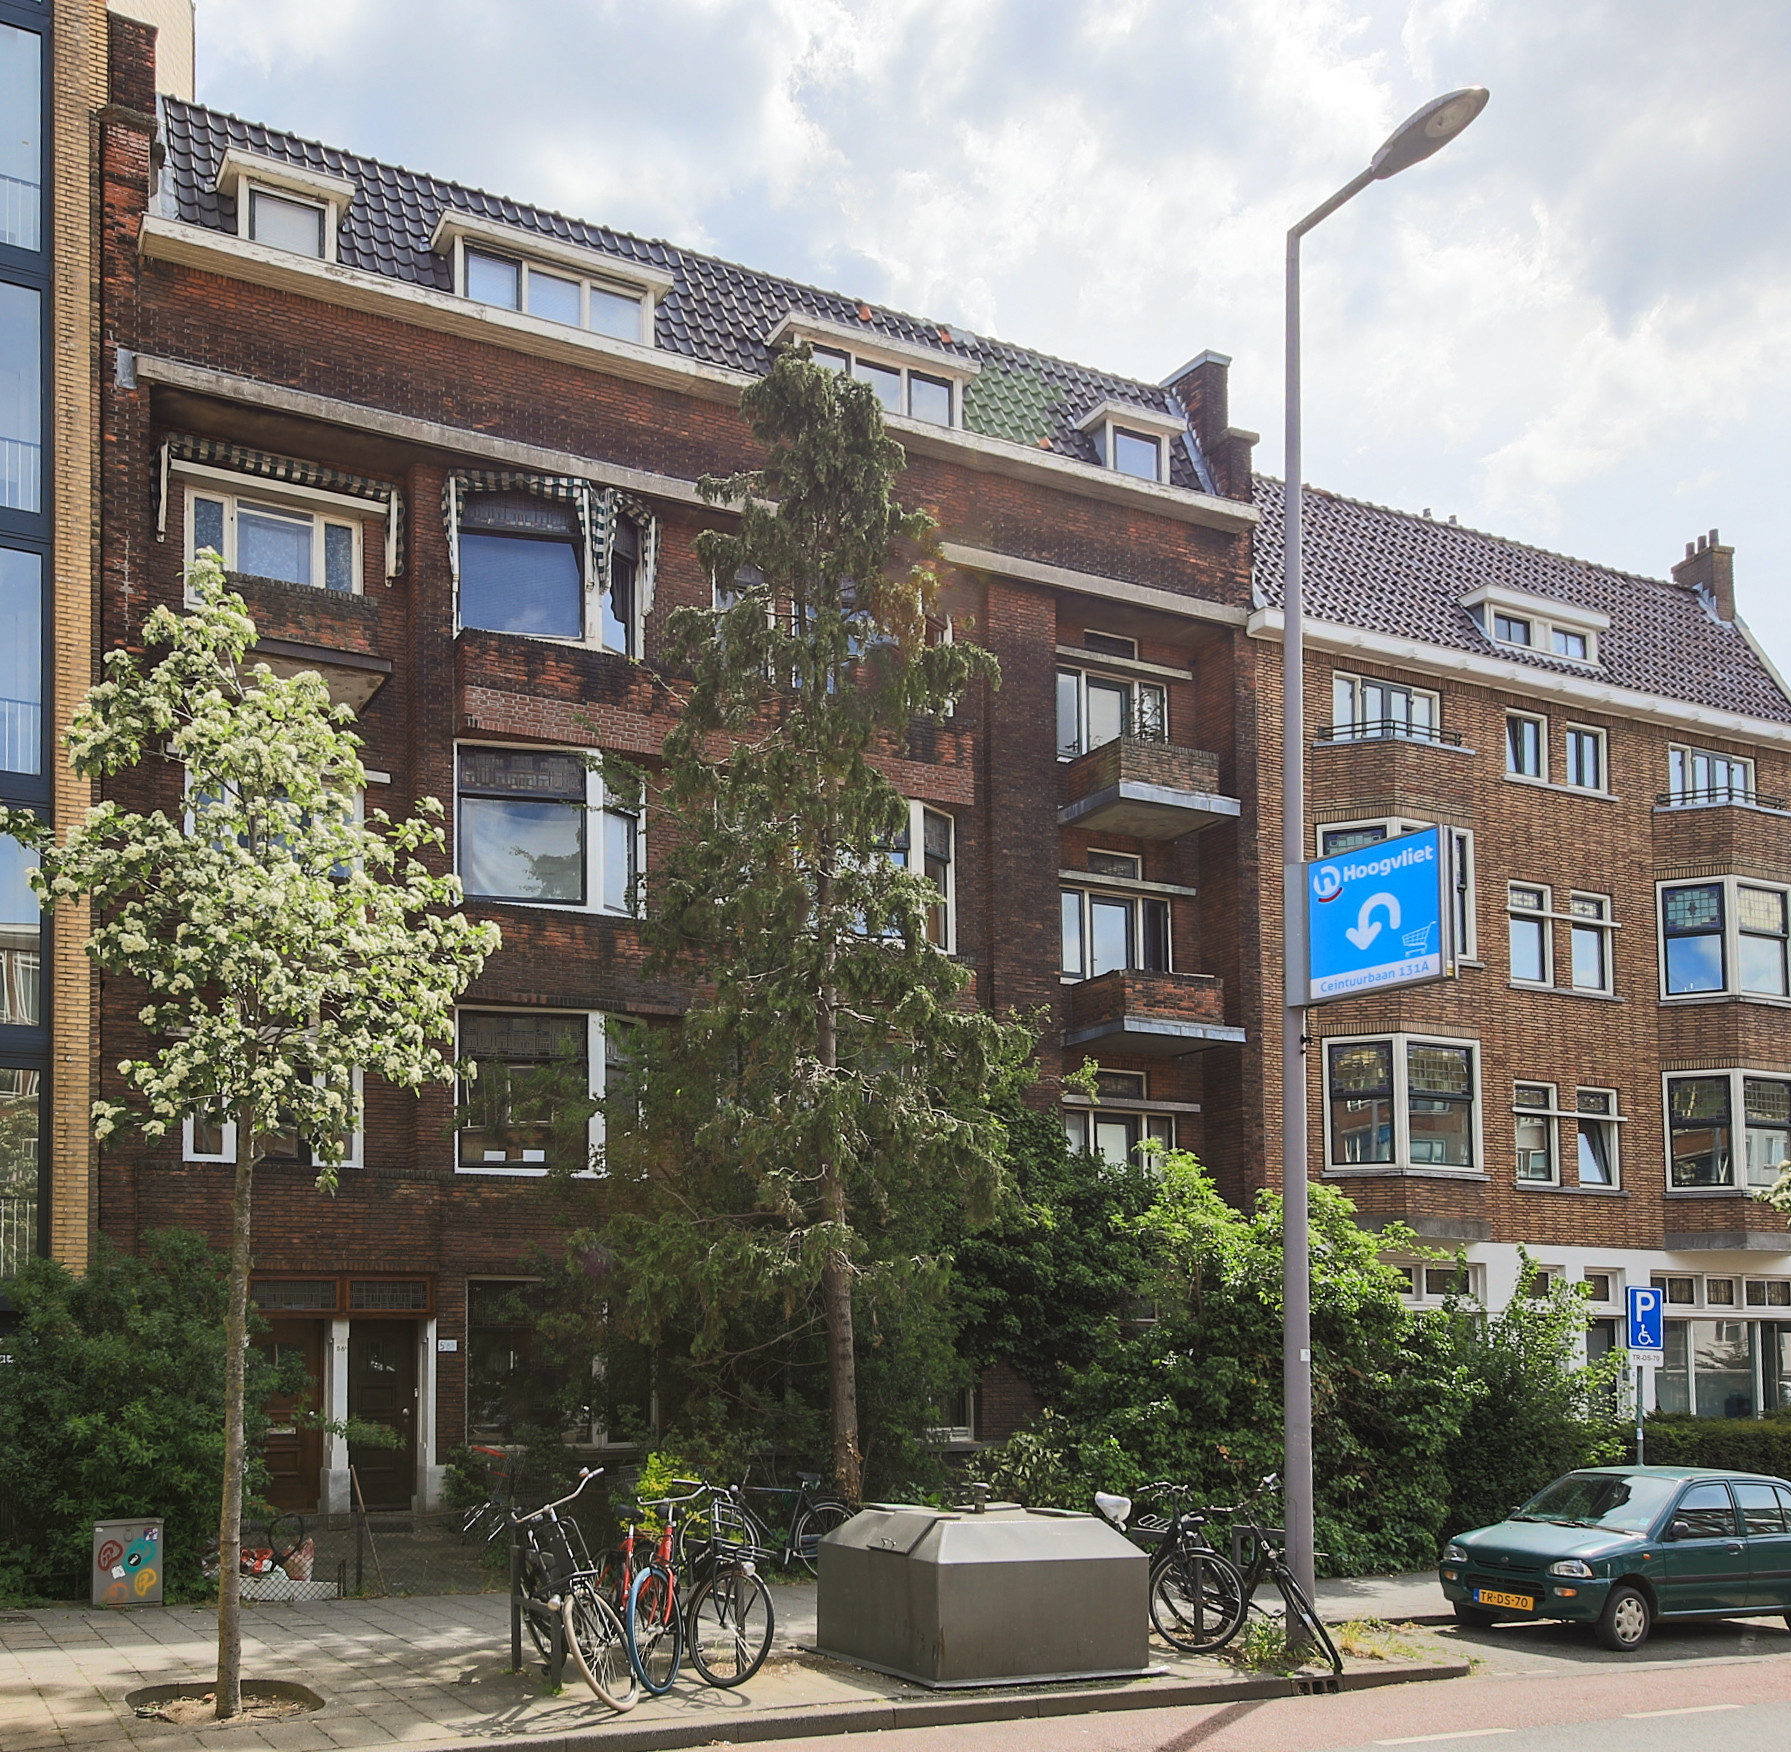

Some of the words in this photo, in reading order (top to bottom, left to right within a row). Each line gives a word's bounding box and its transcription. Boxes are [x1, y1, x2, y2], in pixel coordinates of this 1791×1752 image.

[1343, 845, 1434, 883] Hoogvliet
[1319, 968, 1396, 993] Ceintuurbaan
[1399, 961, 1430, 977] 131A
[1636, 1291, 1656, 1322] P
[1632, 1354, 1660, 1362] TR-DS-70
[1480, 1591, 1529, 1608] TR-DS-70
